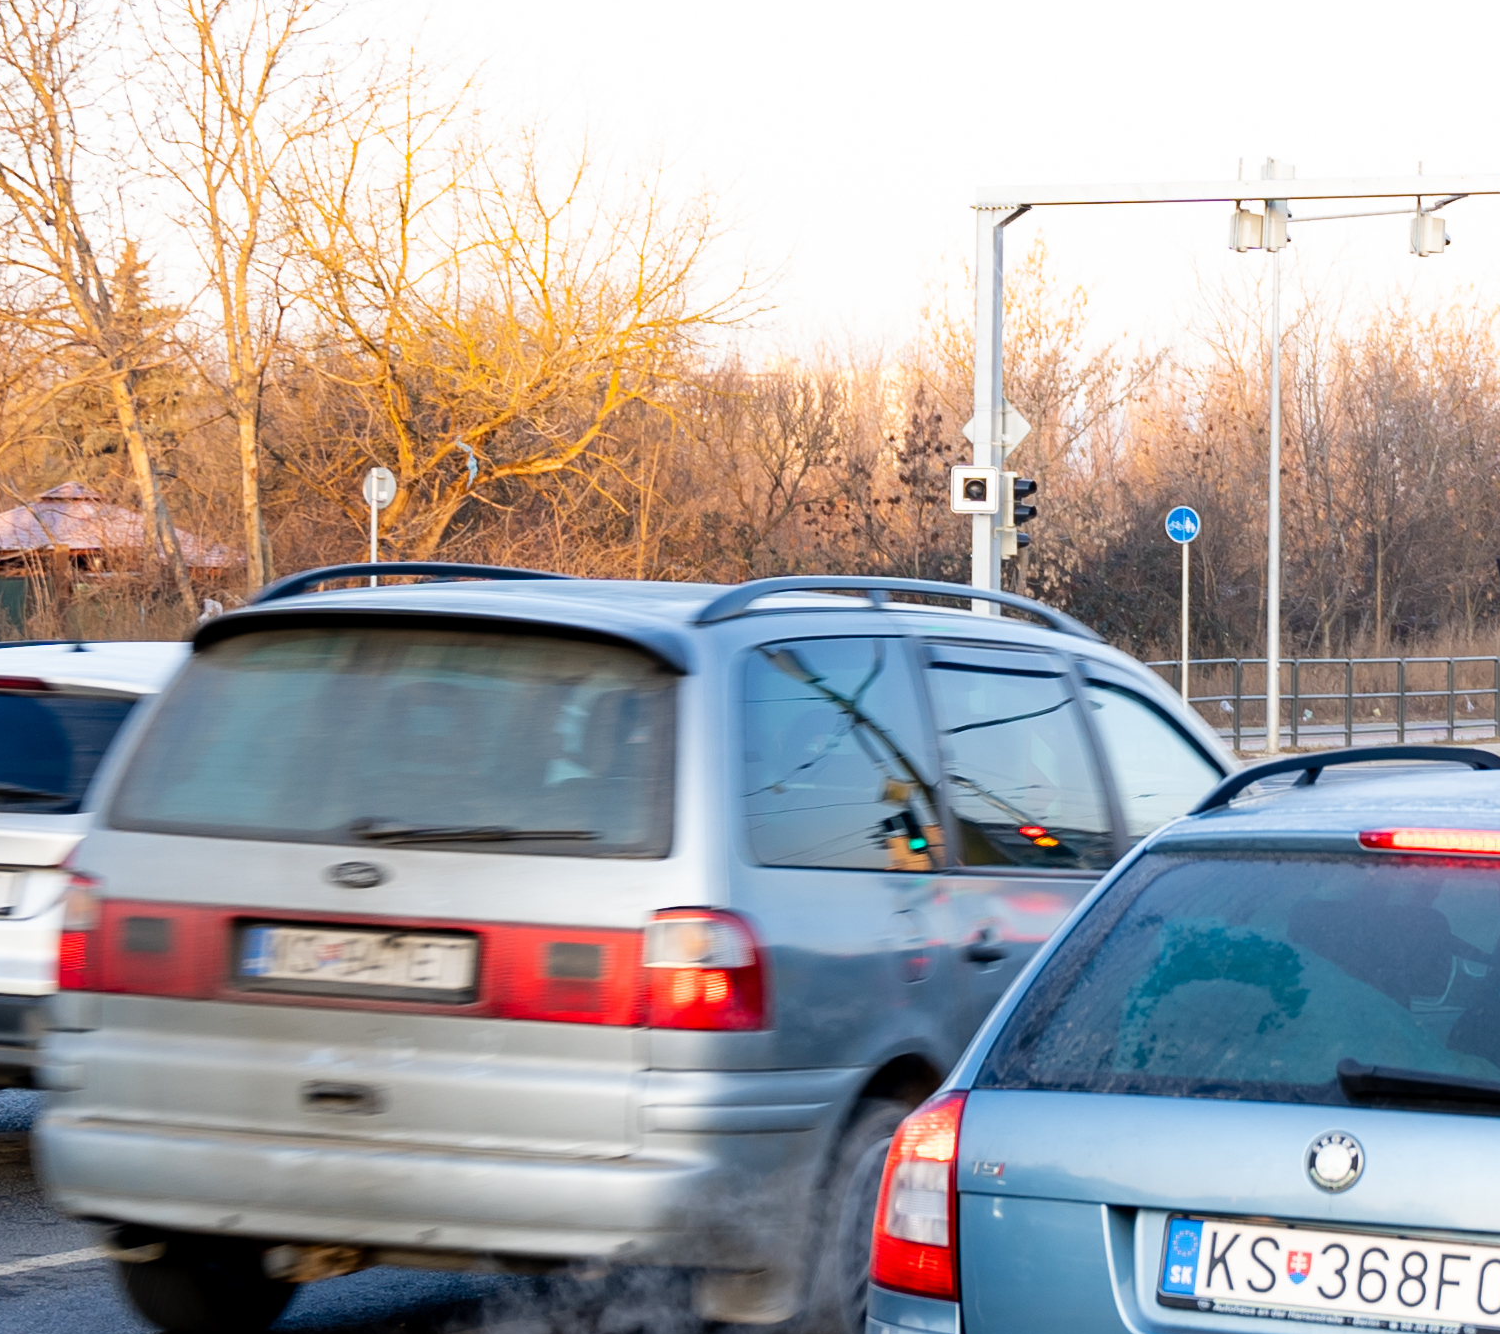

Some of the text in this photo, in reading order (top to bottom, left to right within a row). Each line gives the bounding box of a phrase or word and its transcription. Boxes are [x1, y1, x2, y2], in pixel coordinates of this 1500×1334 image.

[972, 1160, 1005, 1178] TSI
[1206, 1231, 1281, 1293] KS
[1169, 1265, 1193, 1285] SK
